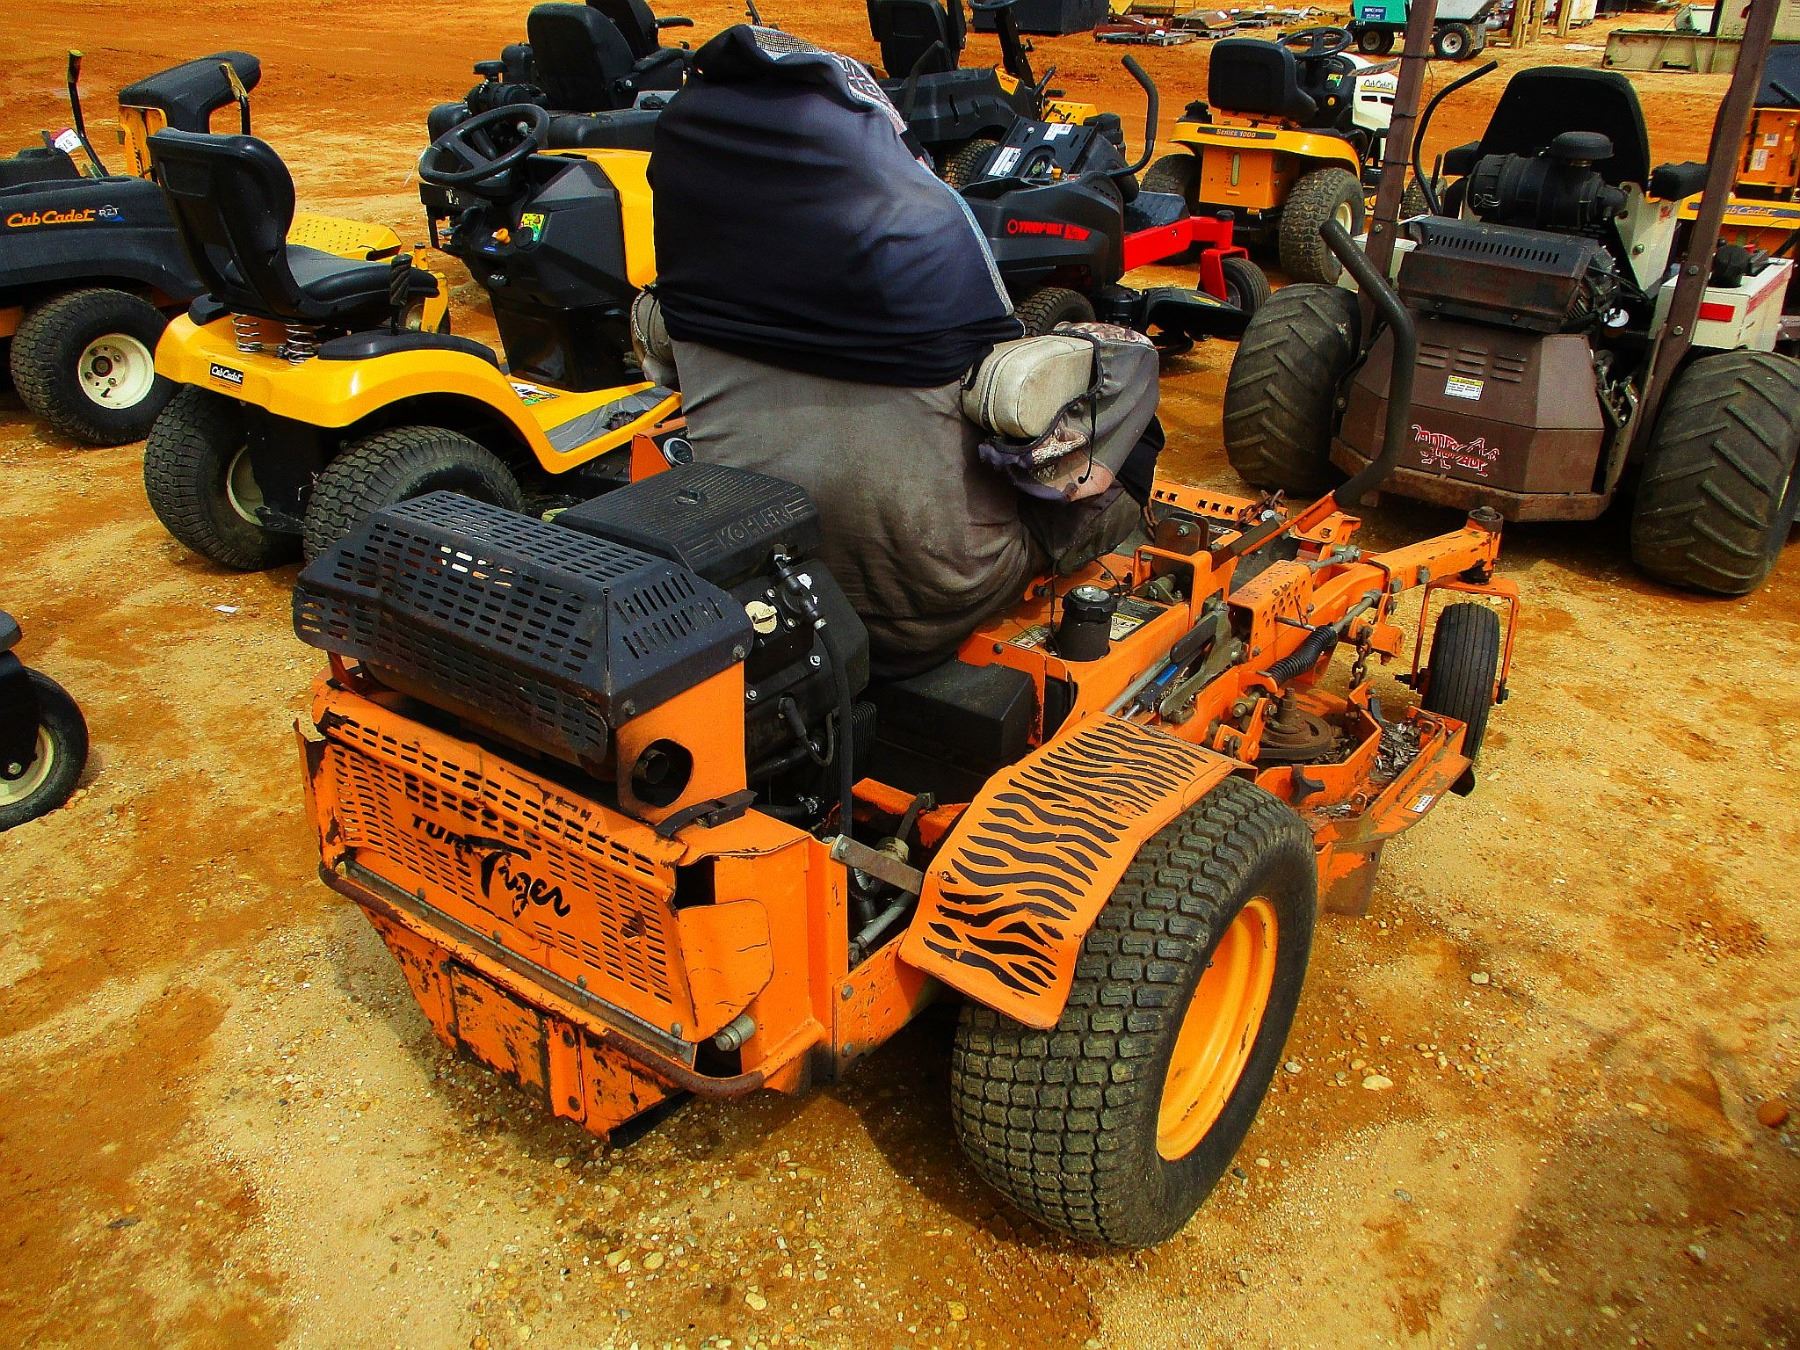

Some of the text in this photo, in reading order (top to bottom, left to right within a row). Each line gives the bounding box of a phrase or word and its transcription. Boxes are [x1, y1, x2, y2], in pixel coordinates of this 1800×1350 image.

[7, 211, 41, 228] Cub
[42, 208, 97, 224] Cadet
[211, 366, 224, 377] Cub
[714, 502, 793, 550] KOHLER
[463, 834, 571, 918] Tiger
